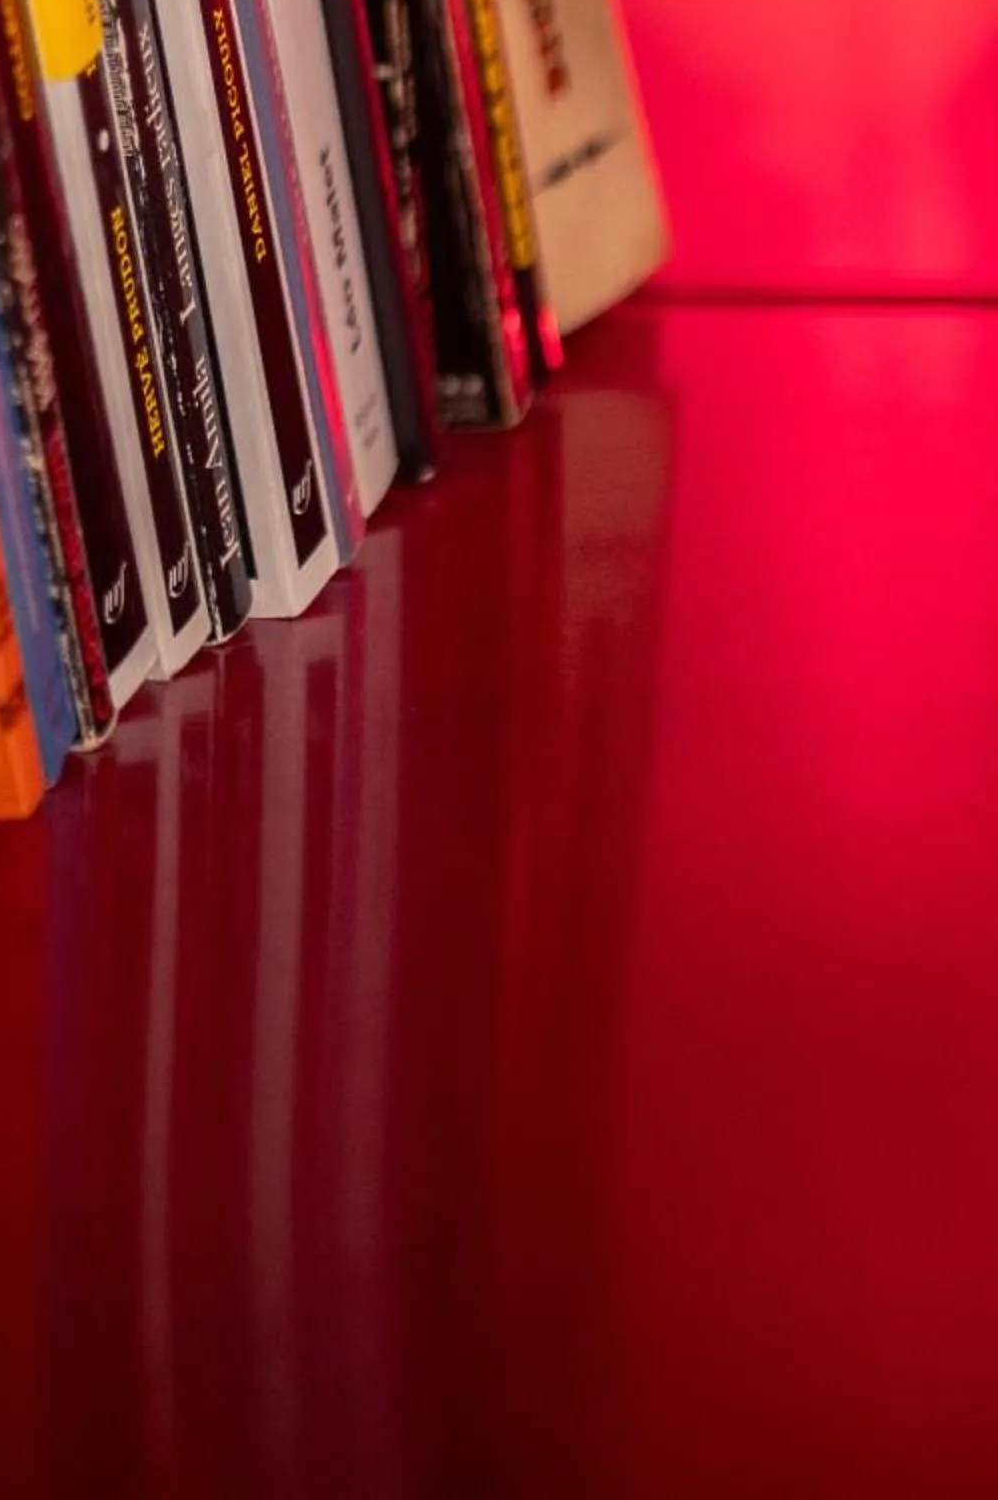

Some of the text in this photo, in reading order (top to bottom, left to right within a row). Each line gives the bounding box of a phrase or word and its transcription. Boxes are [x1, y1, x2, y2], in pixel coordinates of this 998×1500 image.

[137, 20, 172, 171] radieux
[212, 7, 268, 264] DANIEL PICOULY
[110, 204, 145, 344] PRUDON
[135, 345, 166, 458] HERVÉ
[192, 355, 223, 469] Amila
[215, 479, 242, 569] Jean
